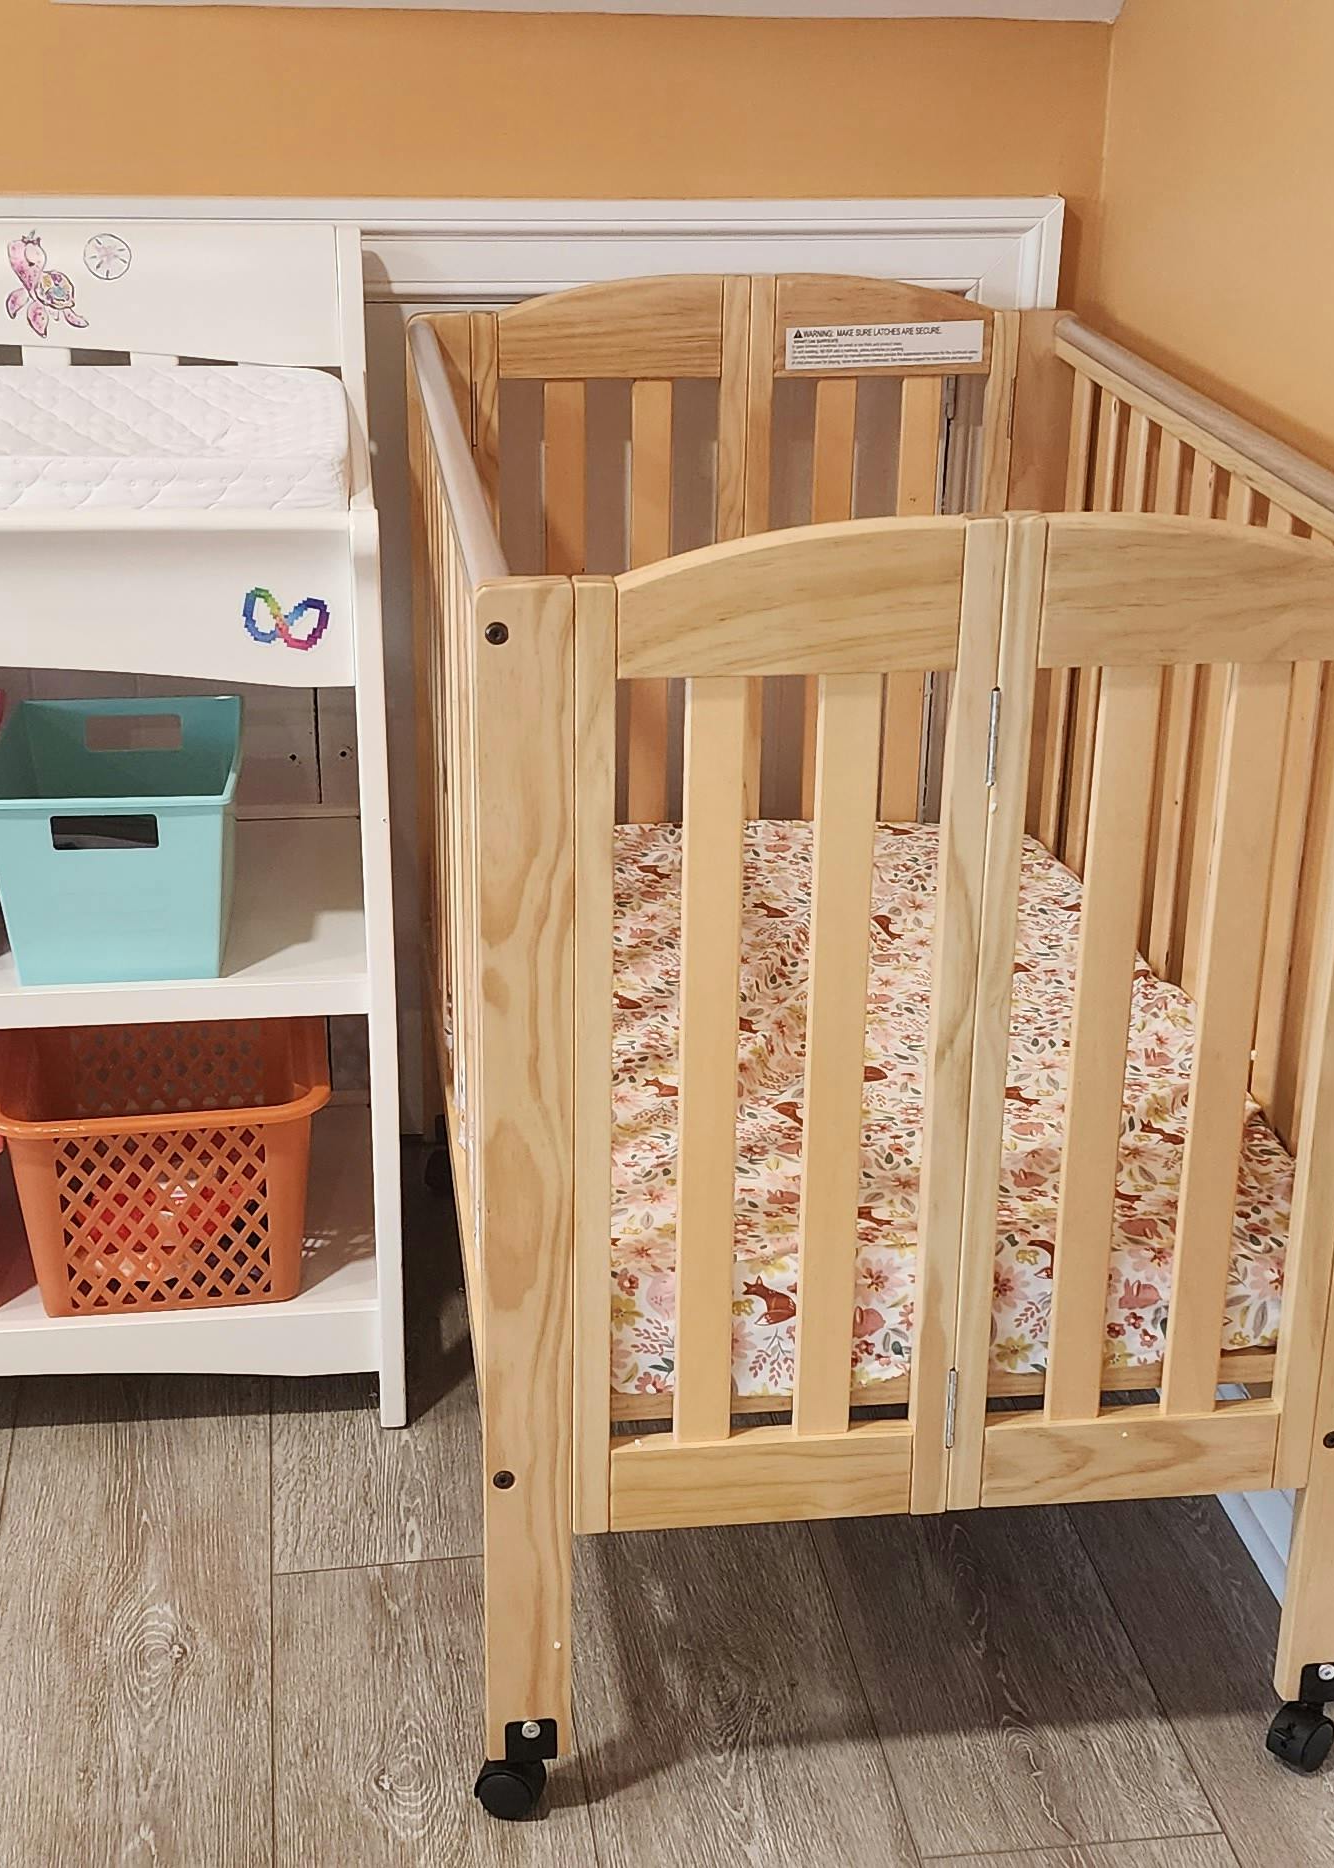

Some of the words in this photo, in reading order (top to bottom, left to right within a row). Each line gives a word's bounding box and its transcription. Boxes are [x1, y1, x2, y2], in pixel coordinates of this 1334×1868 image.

[836, 329, 854, 337] MAKE
[855, 328, 872, 336] SURE
[873, 327, 901, 336] LATCHES
[901, 327, 914, 335] ARE
[915, 326, 942, 335] SECURE.
